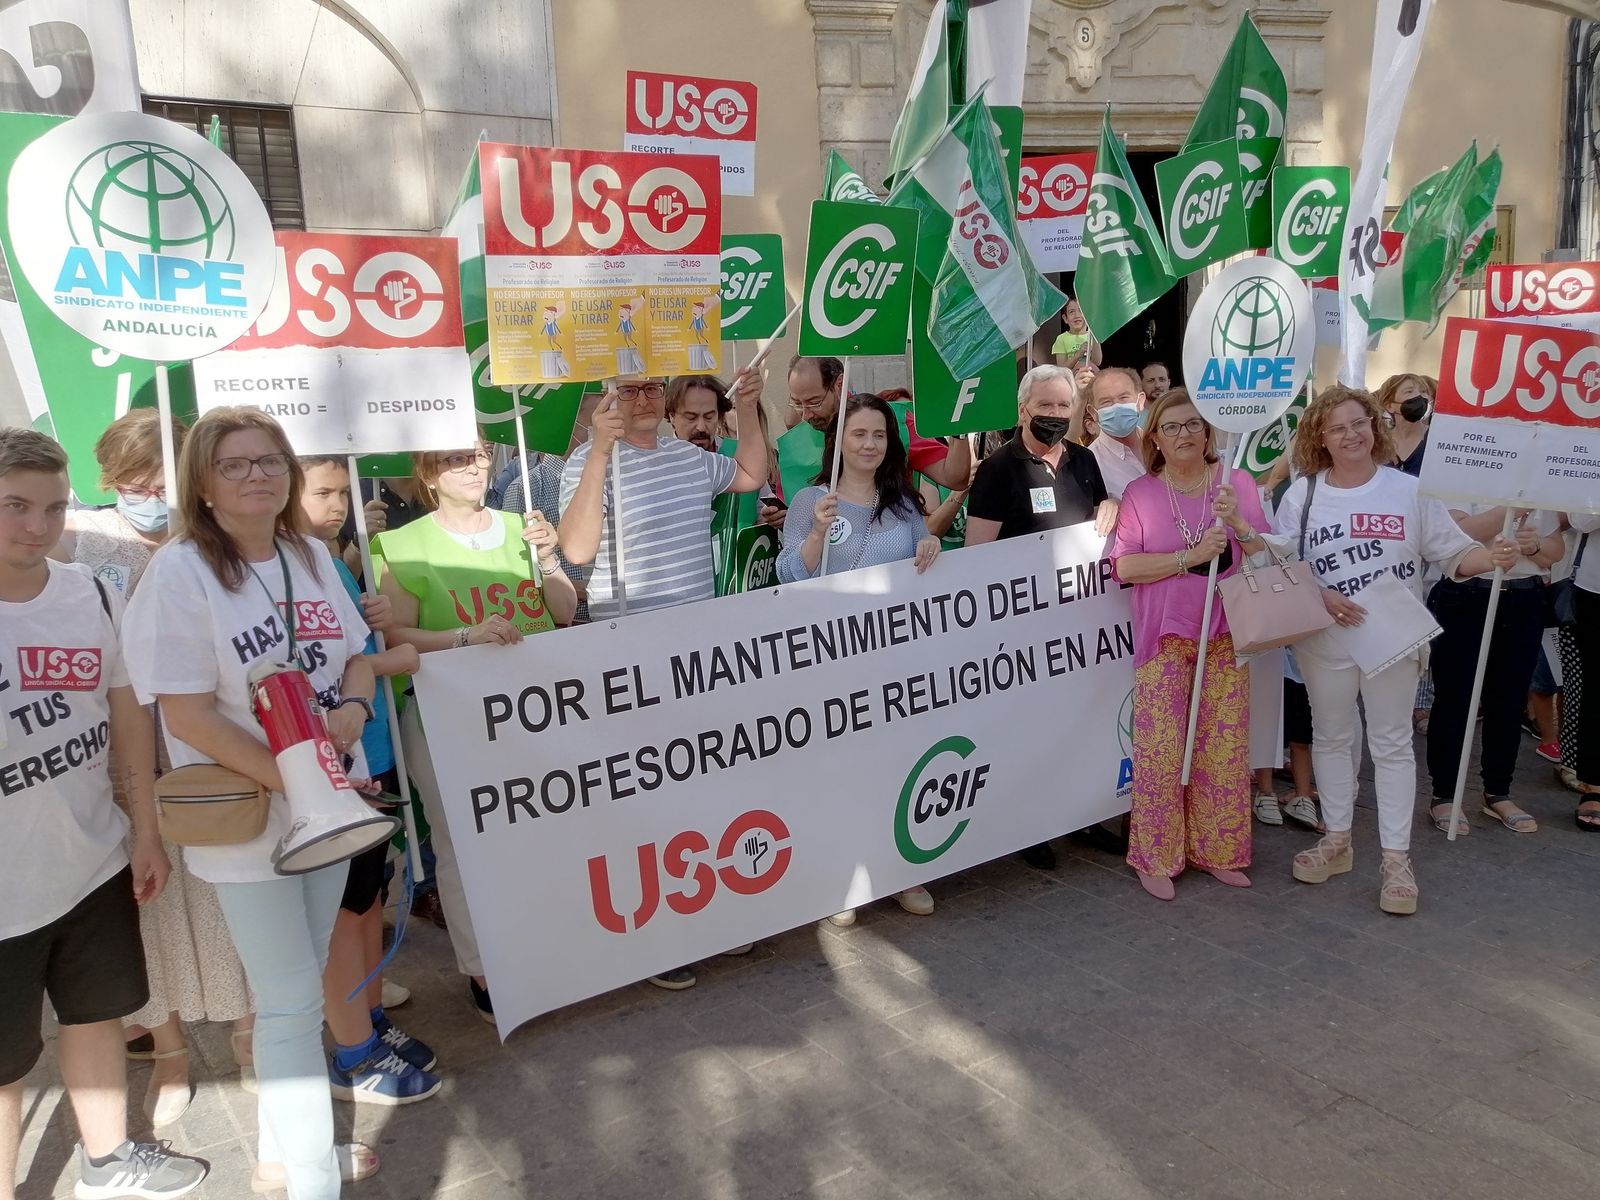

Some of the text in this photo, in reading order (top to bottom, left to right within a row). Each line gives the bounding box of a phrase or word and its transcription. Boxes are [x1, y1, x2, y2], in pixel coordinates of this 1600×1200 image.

[1082, 27, 1090, 43] 5
[635, 78, 749, 135] USO
[631, 144, 675, 154] RECORTE
[720, 165, 745, 174] PIDOS
[1018, 163, 1088, 214] SO
[499, 157, 707, 251] USO
[1182, 182, 1233, 230] CSIF
[1086, 192, 1143, 257] CSIF
[1291, 205, 1343, 237] CSIF
[1041, 235, 1082, 244] PROFESORAD
[54, 246, 248, 308] ANPE
[829, 257, 904, 300] CSIF
[494, 290, 564, 299] NO ERES UN PROFESOR
[571, 288, 637, 299] NO ERES UN PROFESOR
[650, 287, 711, 296] NO ERES UN PROFESOR
[1491, 268, 1595, 312] USO
[54, 295, 248, 318] SINDICATO INDEPENDIENTE
[495, 301, 537, 312] DE USAR
[572, 300, 613, 311] DE USAR
[650, 298, 687, 309] DE USAR
[496, 315, 534, 326] Y TIRAR
[572, 313, 609, 325] Y TIRAR
[650, 311, 684, 321] Y TIRAR
[103, 319, 218, 338] ANDALUCÍA
[1197, 357, 1296, 391] ANPE
[214, 377, 310, 392] RECORTE
[1196, 391, 1292, 400] SINDICATO INDEPENDIENTE
[257, 403, 311, 417] ARIO
[367, 398, 456, 414] DESPIDOS
[1218, 404, 1267, 415] CÓRDOBA
[1463, 433, 1496, 444] POR EL
[1437, 442, 1518, 459] MANTENIMIENTO
[1573, 445, 1588, 454] DEL
[1445, 456, 1503, 470] DEL EMPLEO
[1549, 468, 1561, 476] DE
[1352, 514, 1403, 533] USO
[1309, 524, 1344, 549] HAZ
[1315, 539, 1384, 576] DE TUS
[749, 557, 775, 589] CSIF
[448, 579, 545, 625] USO
[231, 615, 284, 664] HAZ
[20, 649, 99, 680] USO
[482, 678, 590, 742] POR
[602, 665, 661, 716] EL
[670, 590, 977, 700] MANTENIMIENTO
[987, 574, 1049, 622] DEL
[9, 691, 72, 736] TUS
[470, 621, 1135, 834] PROFESORADO DE RELIGIÓN EN AN
[0, 720, 109, 797] ERECHO
[914, 763, 991, 825] CSIF
[587, 809, 792, 934] USO
